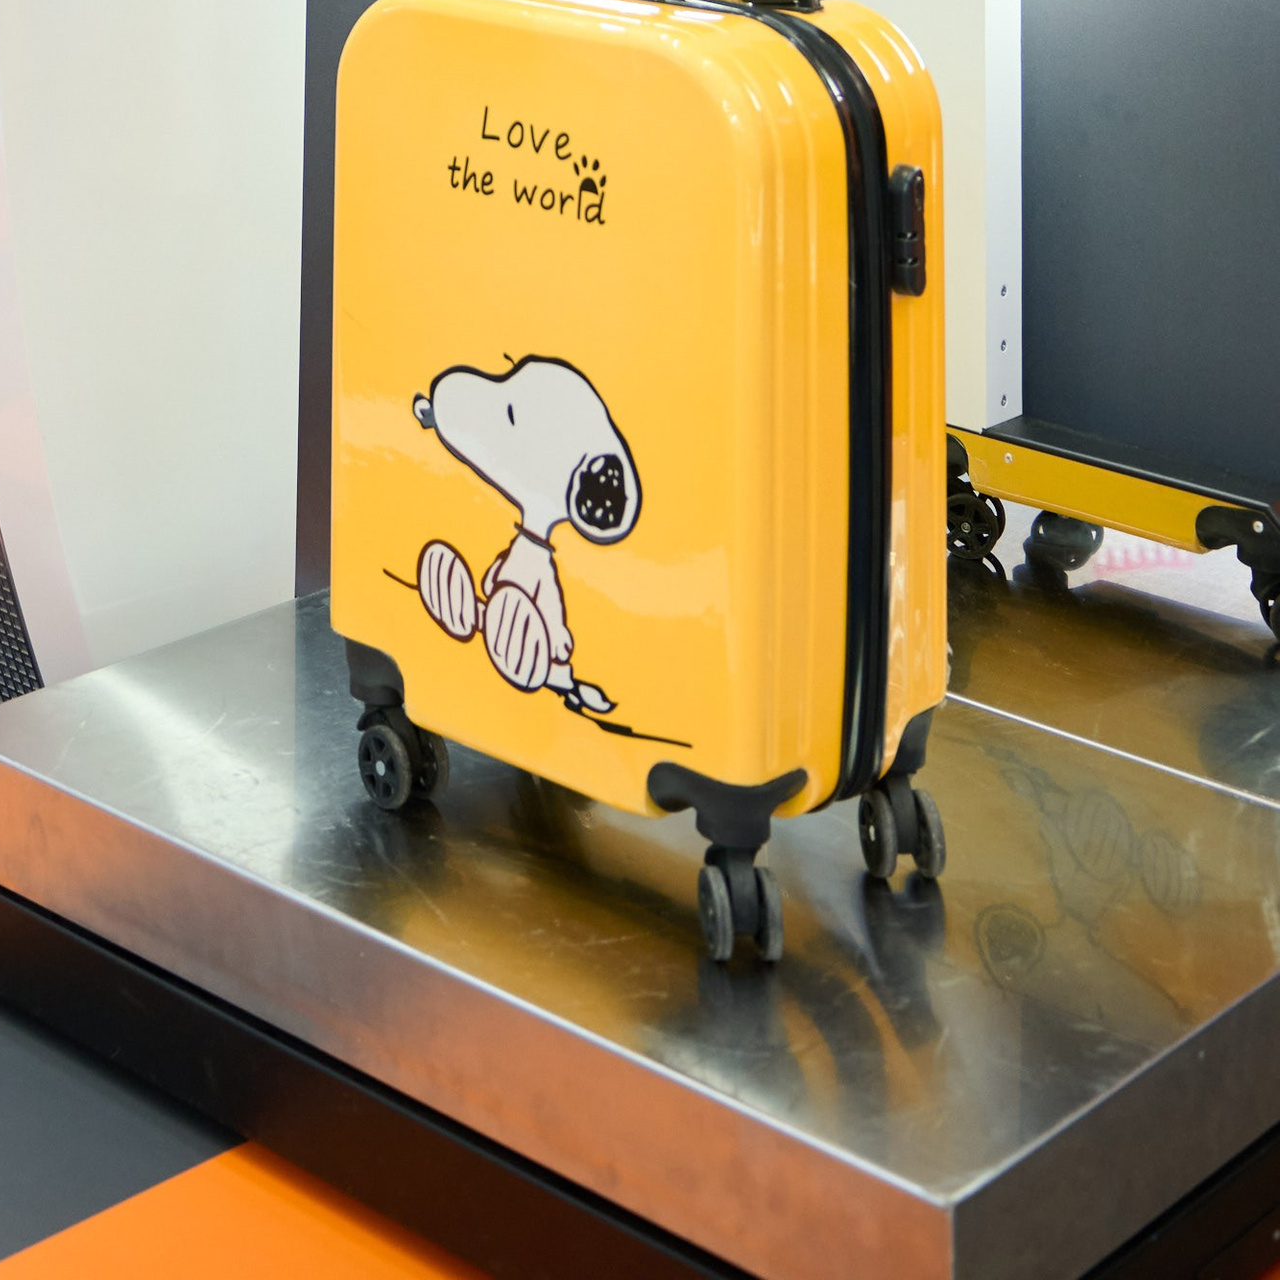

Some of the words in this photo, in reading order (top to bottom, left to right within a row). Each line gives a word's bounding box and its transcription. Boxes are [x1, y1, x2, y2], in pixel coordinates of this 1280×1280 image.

[481, 106, 572, 160] Love
[448, 156, 494, 196] the
[514, 177, 606, 225] world
